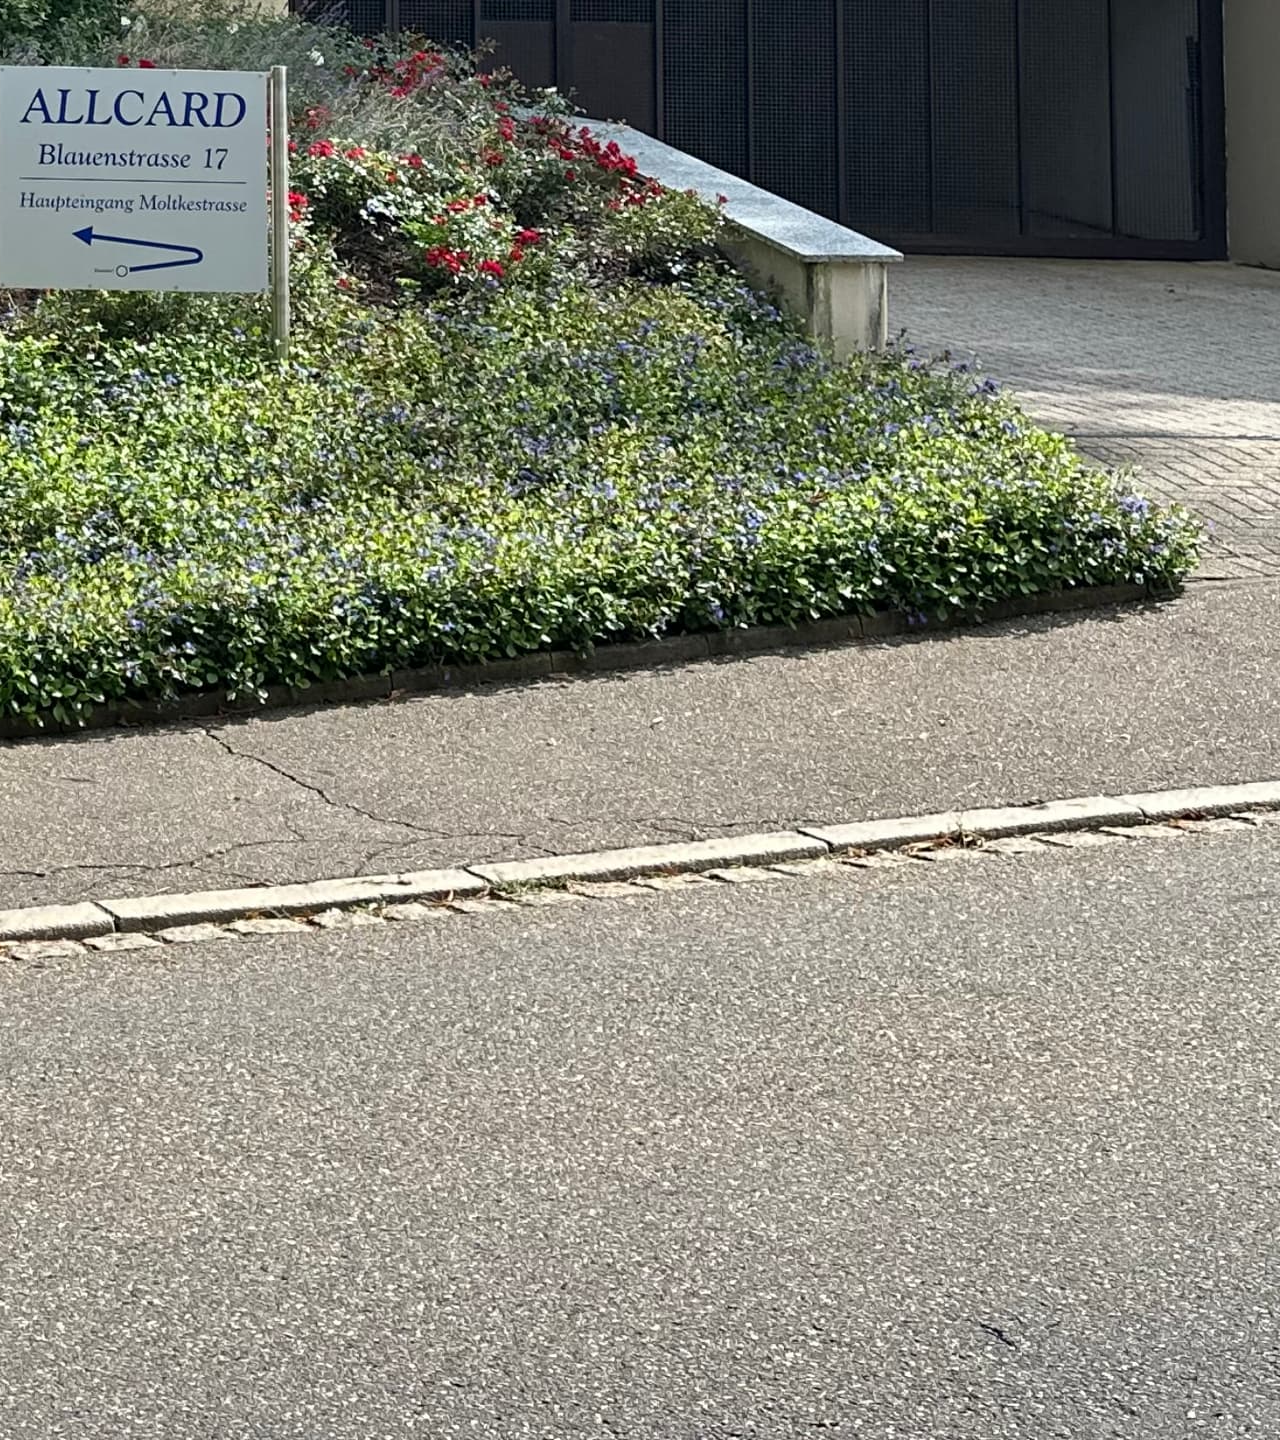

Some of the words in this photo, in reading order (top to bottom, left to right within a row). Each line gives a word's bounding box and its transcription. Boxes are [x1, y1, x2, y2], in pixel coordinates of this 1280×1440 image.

[19, 87, 247, 128] ALLCARD
[37, 143, 191, 169] Blauenstrasse
[203, 148, 229, 170] 17
[19, 191, 134, 213] Haupteingang
[139, 193, 248, 213] Moltkestrasse
